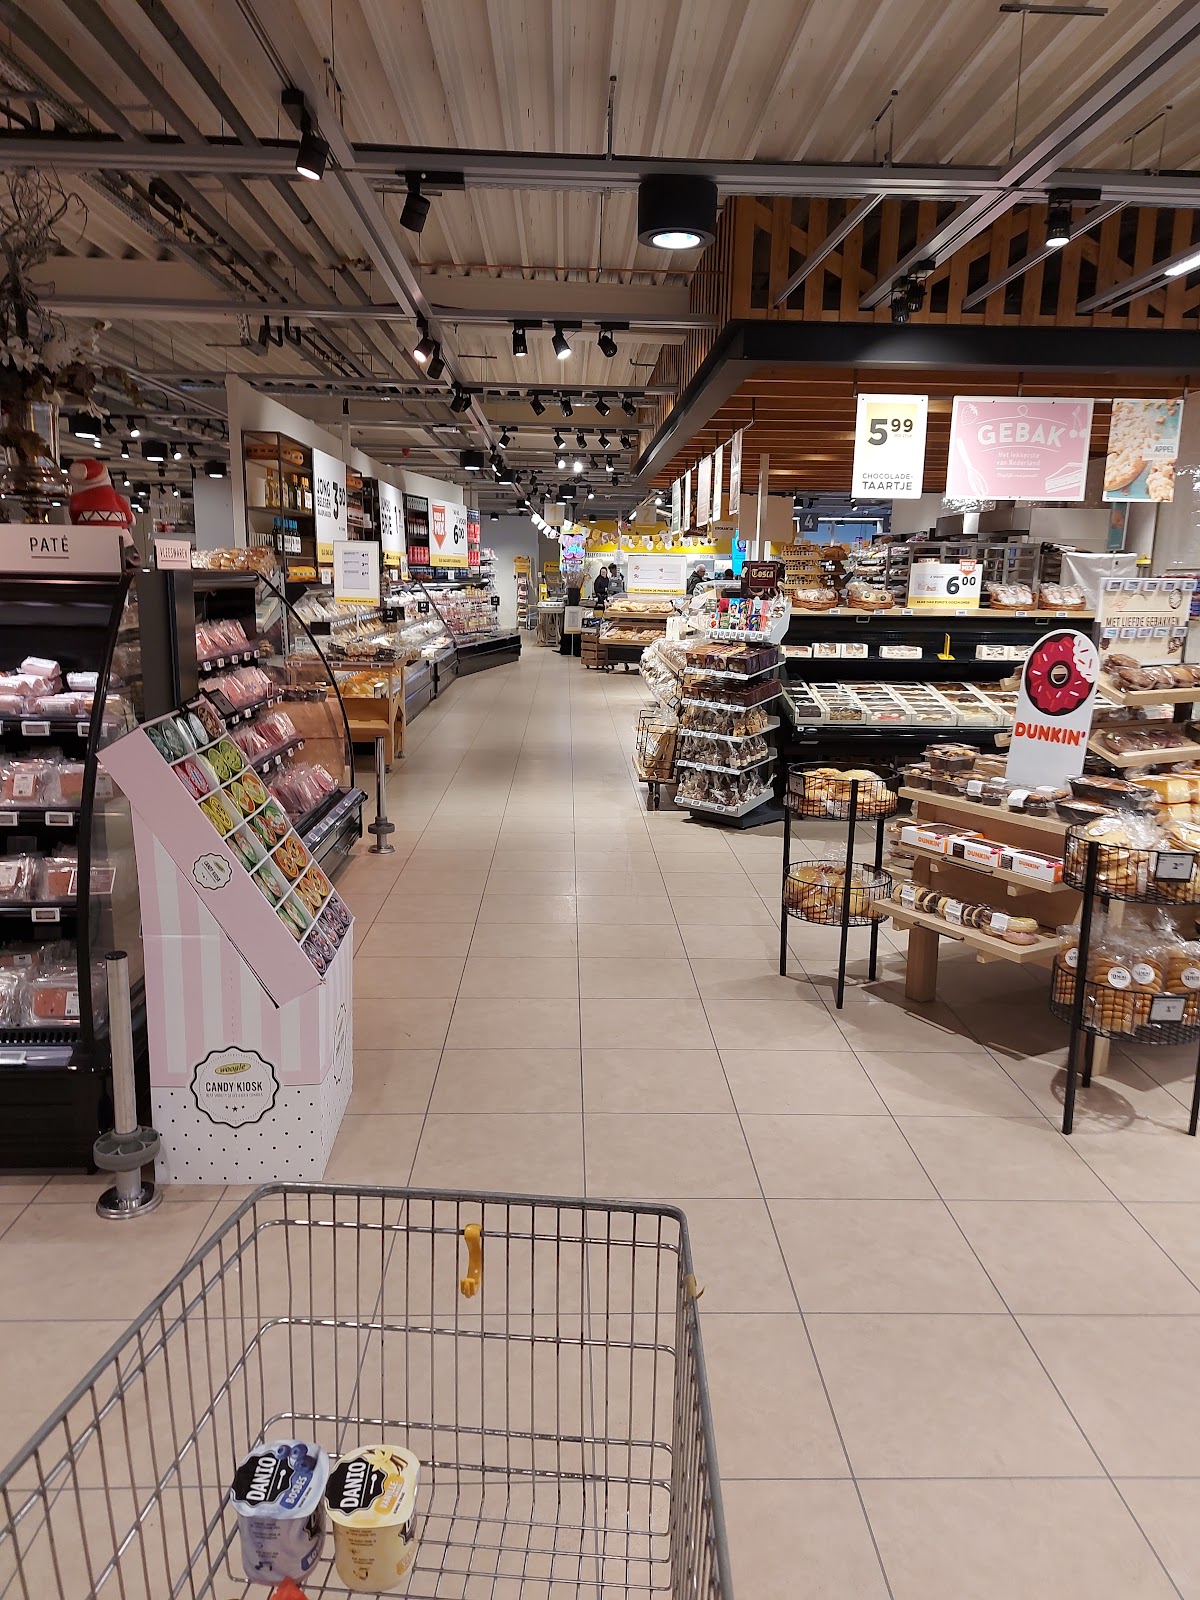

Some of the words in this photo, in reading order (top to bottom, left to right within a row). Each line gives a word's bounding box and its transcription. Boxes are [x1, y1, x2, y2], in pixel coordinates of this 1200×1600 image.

[977, 422, 1066, 448] GEBAK
[1154, 444, 1174, 453] APPEL
[862, 481, 912, 490] TAARTJE
[643, 508, 651, 521] 2
[804, 514, 814, 529] 4
[434, 521, 445, 536] MIX
[29, 534, 70, 553] PATÉ
[160, 547, 188, 559] VLEESWAREN
[752, 568, 774, 578] Tosca
[1106, 617, 1121, 626] MET
[1122, 617, 1145, 626] LIEFDE
[1014, 722, 1087, 746] DUNKIN'
[206, 1082, 234, 1092] CANDY
[236, 1081, 263, 1092] KIOSK
[246, 1456, 277, 1502] DANIO
[340, 1462, 367, 1508] DANIO
[285, 1476, 308, 1504] BOSBES
